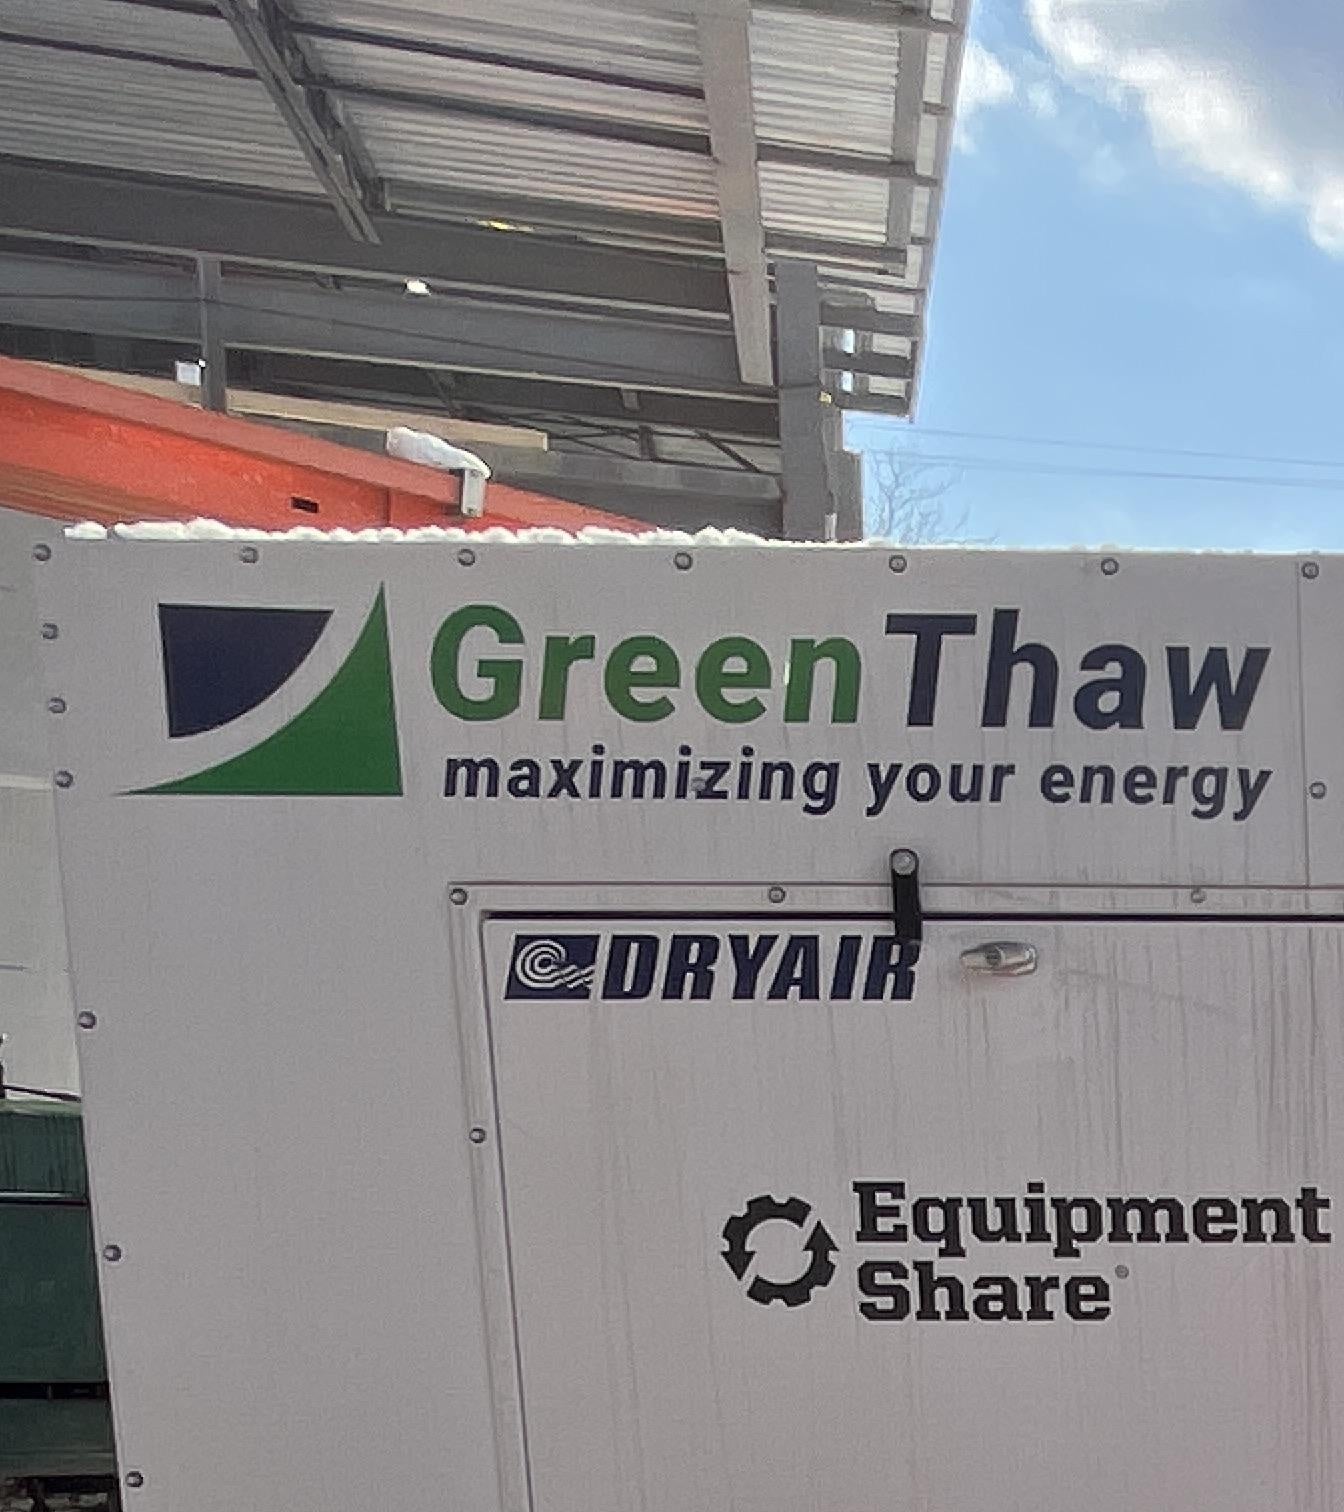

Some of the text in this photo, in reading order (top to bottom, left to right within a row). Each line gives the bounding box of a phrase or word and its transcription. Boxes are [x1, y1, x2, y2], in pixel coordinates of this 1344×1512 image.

[443, 744, 1274, 822] maximizing your energy
[602, 934, 920, 1001] DRYAIR
[852, 1181, 1332, 1257] Equipment
[858, 1261, 1110, 1321] Share
